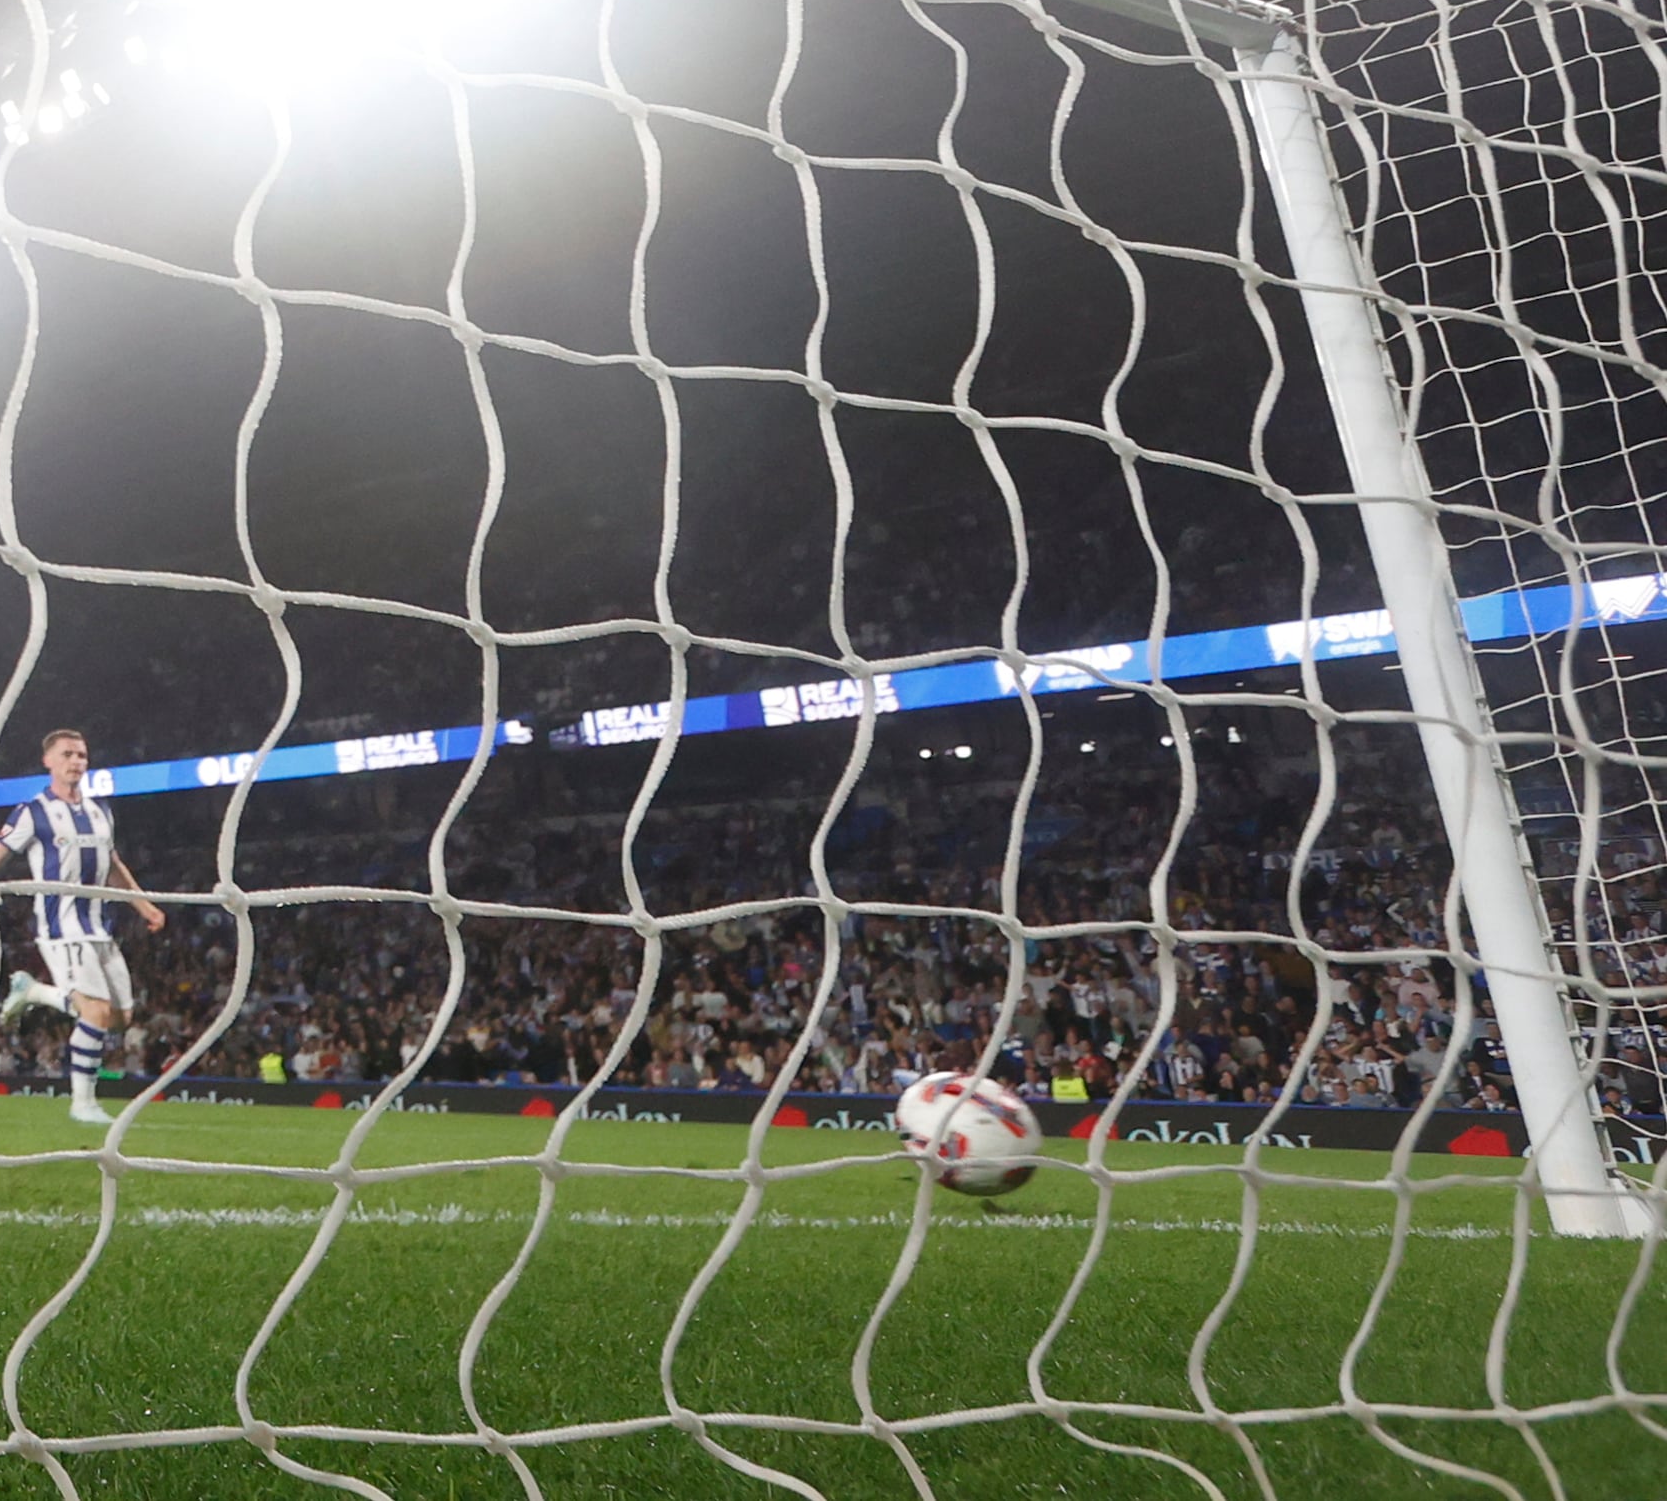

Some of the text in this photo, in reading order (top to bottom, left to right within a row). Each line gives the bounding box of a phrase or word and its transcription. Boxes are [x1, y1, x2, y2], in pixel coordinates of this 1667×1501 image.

[1323, 609, 1394, 643] SWA
[598, 724, 682, 745] SEGURO
[63, 942, 83, 966] 17
